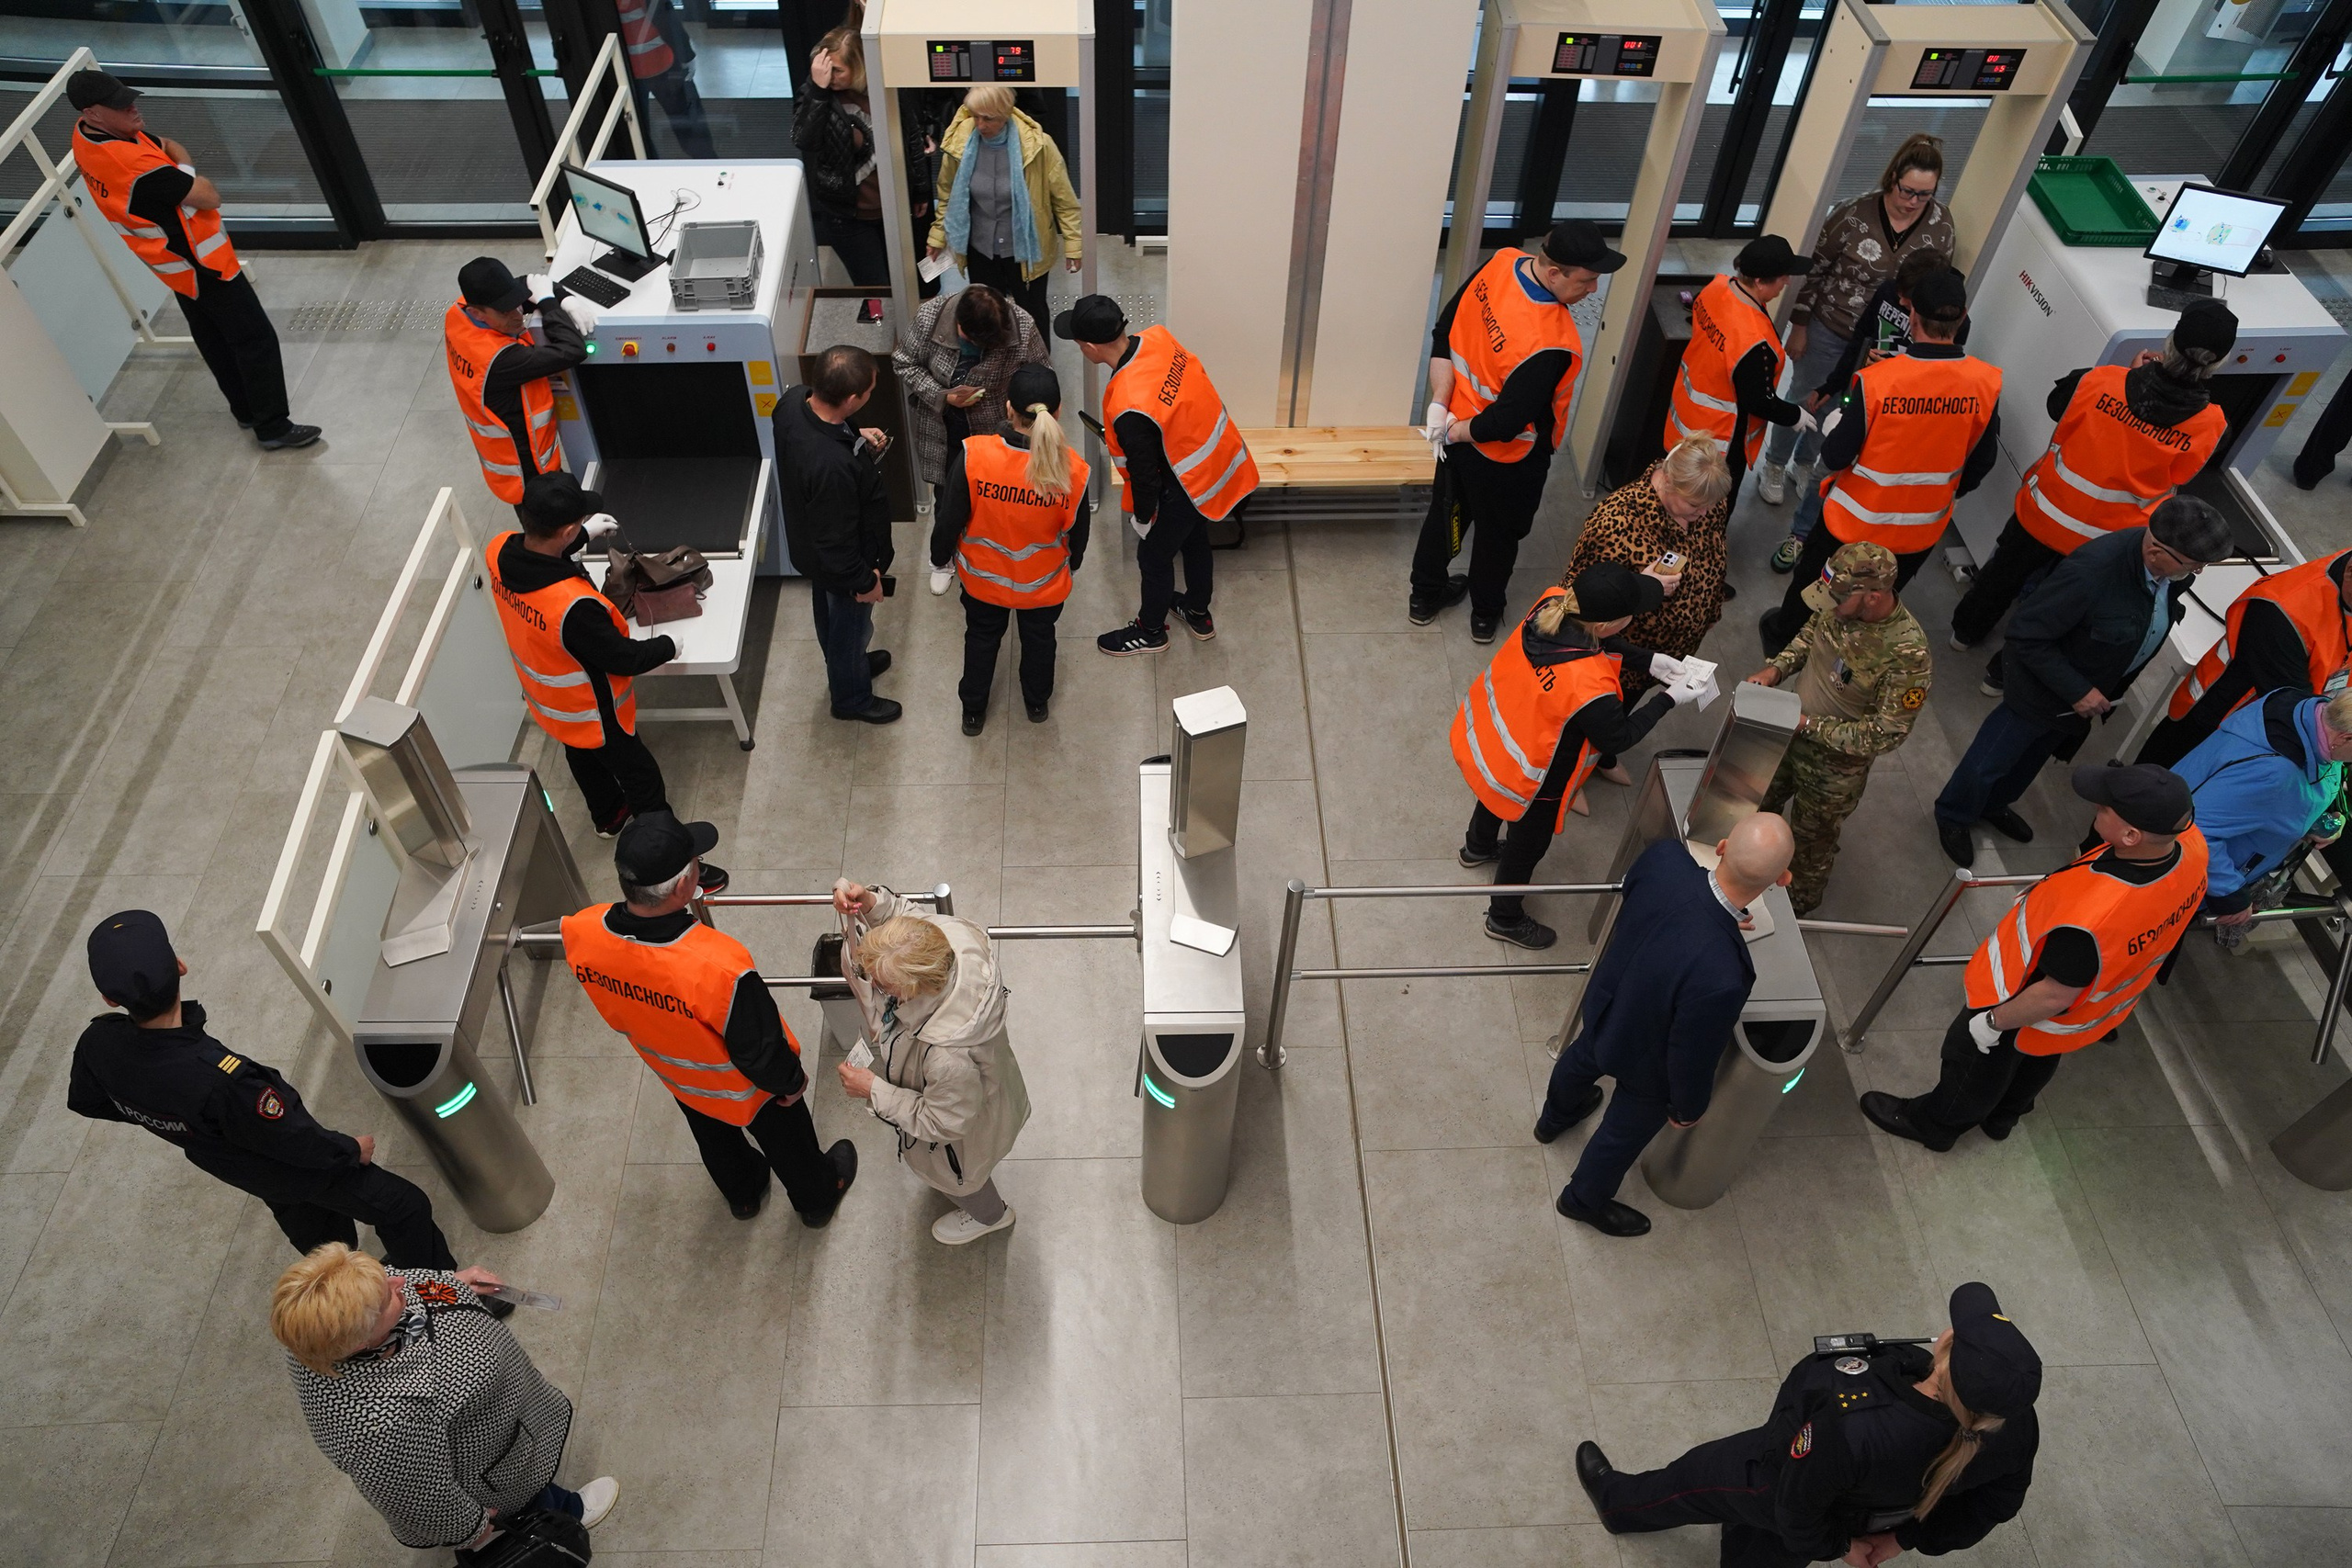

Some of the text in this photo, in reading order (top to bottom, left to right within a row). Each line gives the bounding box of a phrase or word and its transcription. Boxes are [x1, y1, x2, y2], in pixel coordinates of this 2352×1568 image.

[2019, 270, 2053, 317] HIKVISION
[1882, 397, 1980, 414] БЕЗОПАСНОСТЬ
[576, 964, 694, 1020] БЕЗОПАСНОСТЬ
